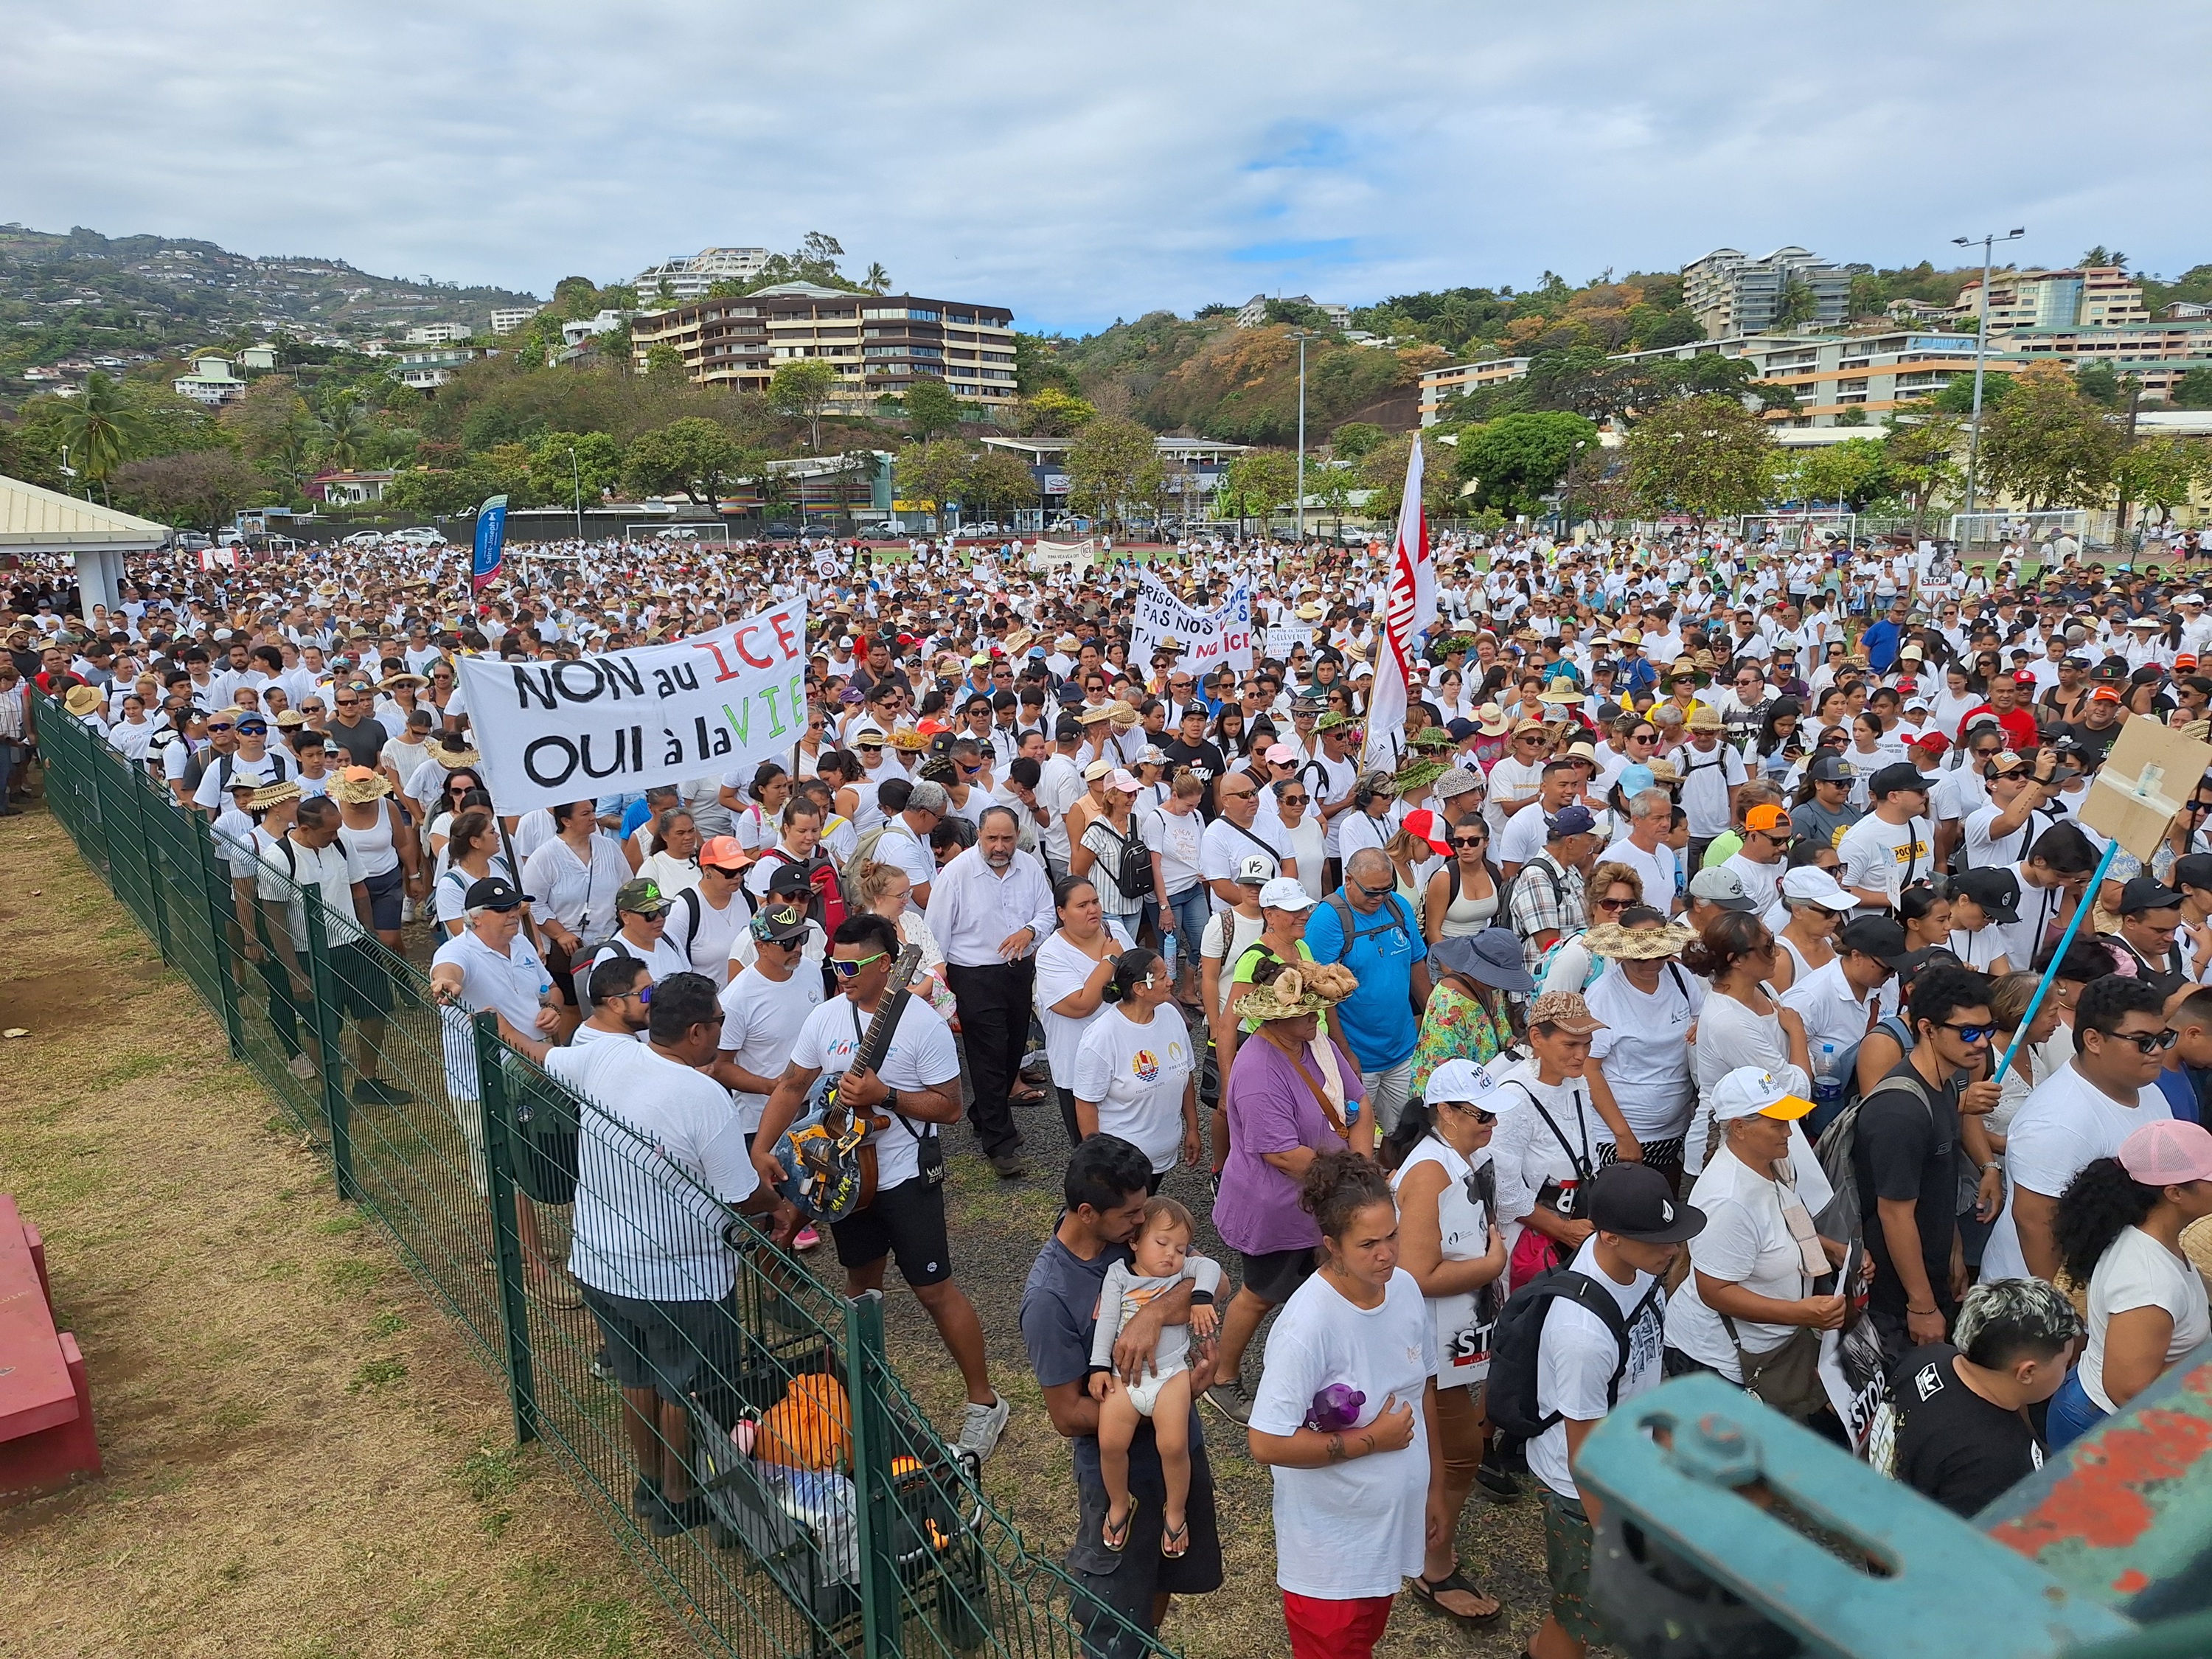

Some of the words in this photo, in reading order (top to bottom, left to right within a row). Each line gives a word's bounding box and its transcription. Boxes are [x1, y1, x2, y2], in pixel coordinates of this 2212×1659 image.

[486, 522, 495, 564] Saint-Joseph
[1143, 604, 1169, 627] PAS
[1175, 616, 1213, 635] NOS
[512, 655, 646, 710] NON
[653, 661, 700, 700] au
[692, 612, 799, 683] ICE
[1196, 641, 1217, 658] NO
[524, 726, 643, 787] OUI
[664, 728, 683, 766] à
[695, 716, 732, 761] la
[722, 674, 804, 748] VIE
[1471, 1066, 1484, 1079] NO
[1479, 1077, 1492, 1090] ICE
[818, 1078, 834, 1108] CAT
[1851, 1370, 1885, 1435] STOP
